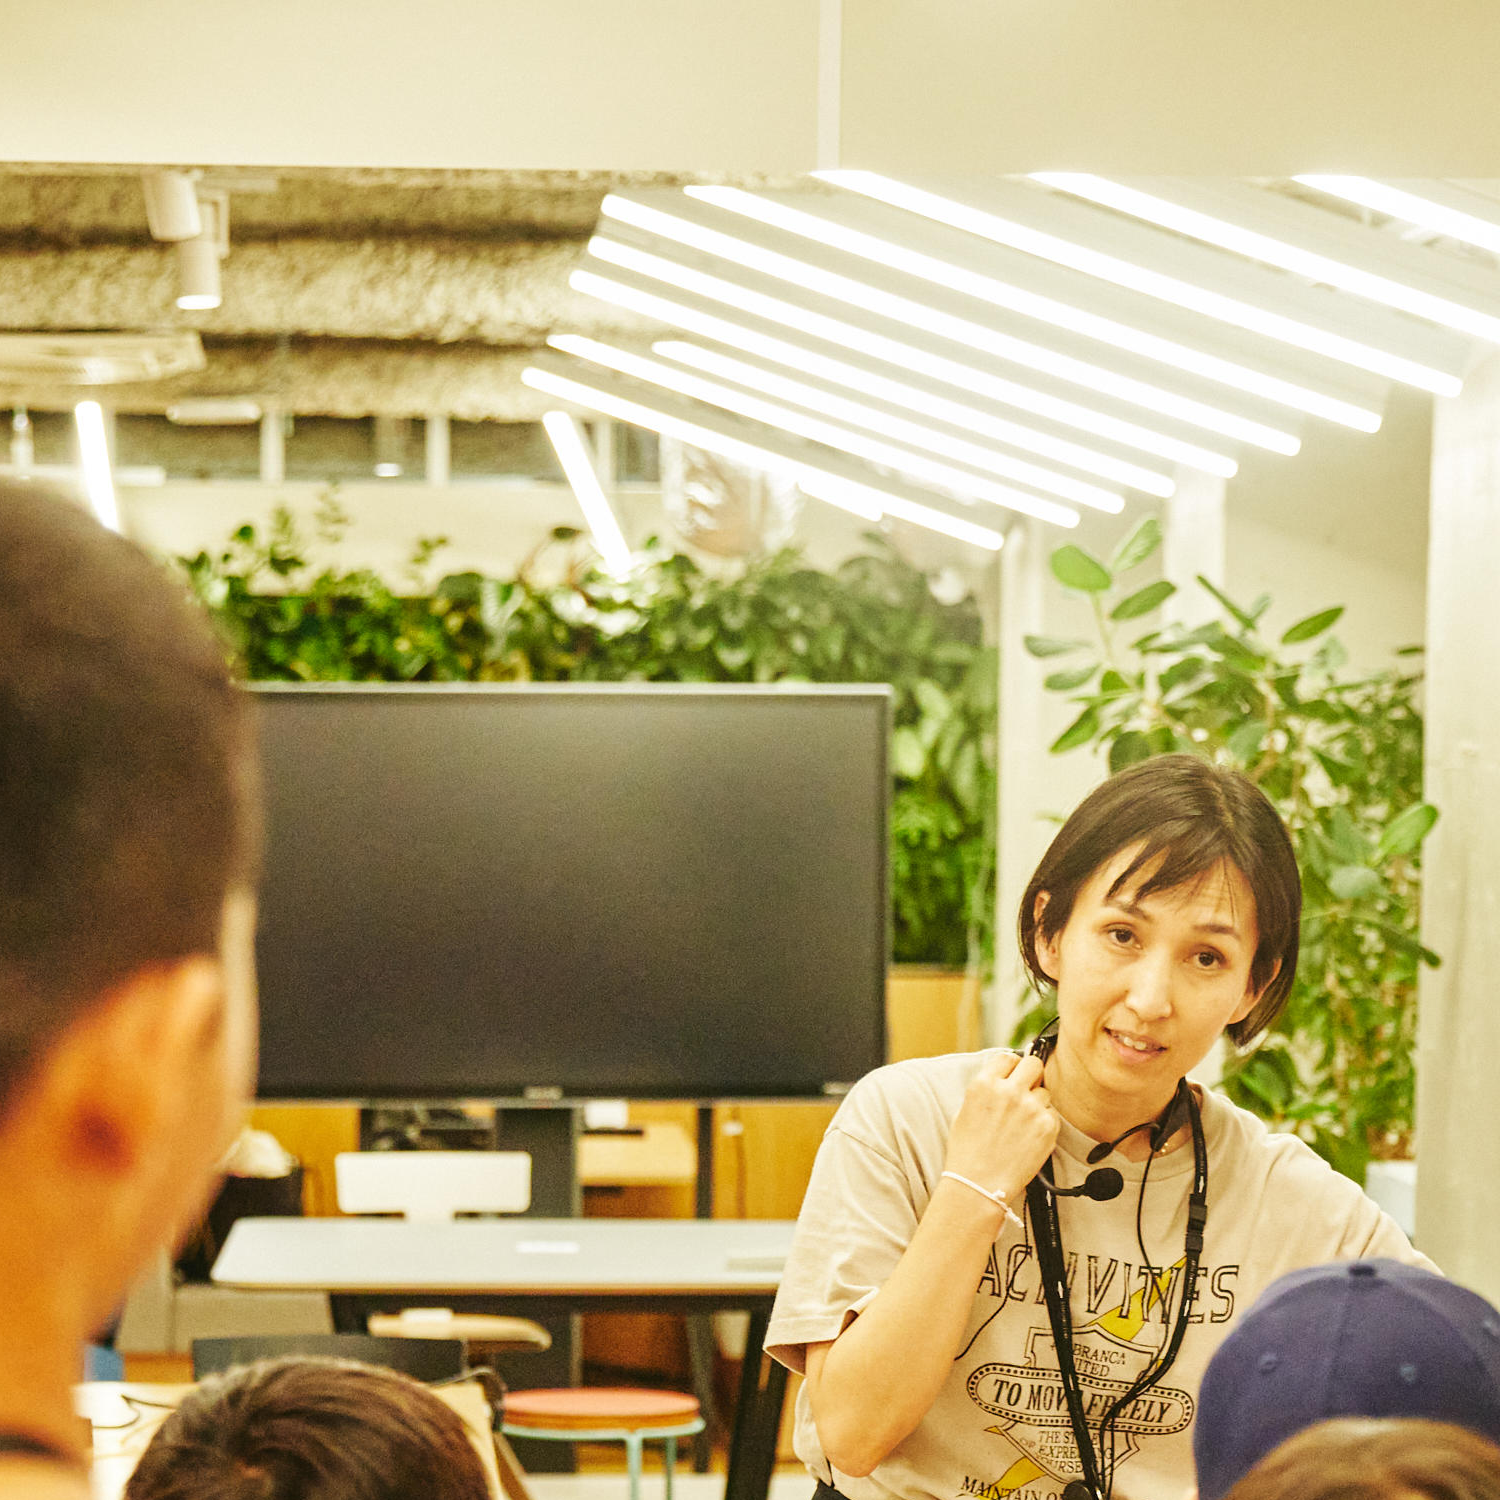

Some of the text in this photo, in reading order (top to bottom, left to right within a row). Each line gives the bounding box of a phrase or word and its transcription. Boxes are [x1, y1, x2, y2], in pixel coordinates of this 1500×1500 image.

[976, 1243, 1240, 1325] ACIVITIES
[993, 1378, 1022, 1407] TO
[1026, 1383, 1082, 1413] MOV
[1037, 1430, 1100, 1446] THE STE
